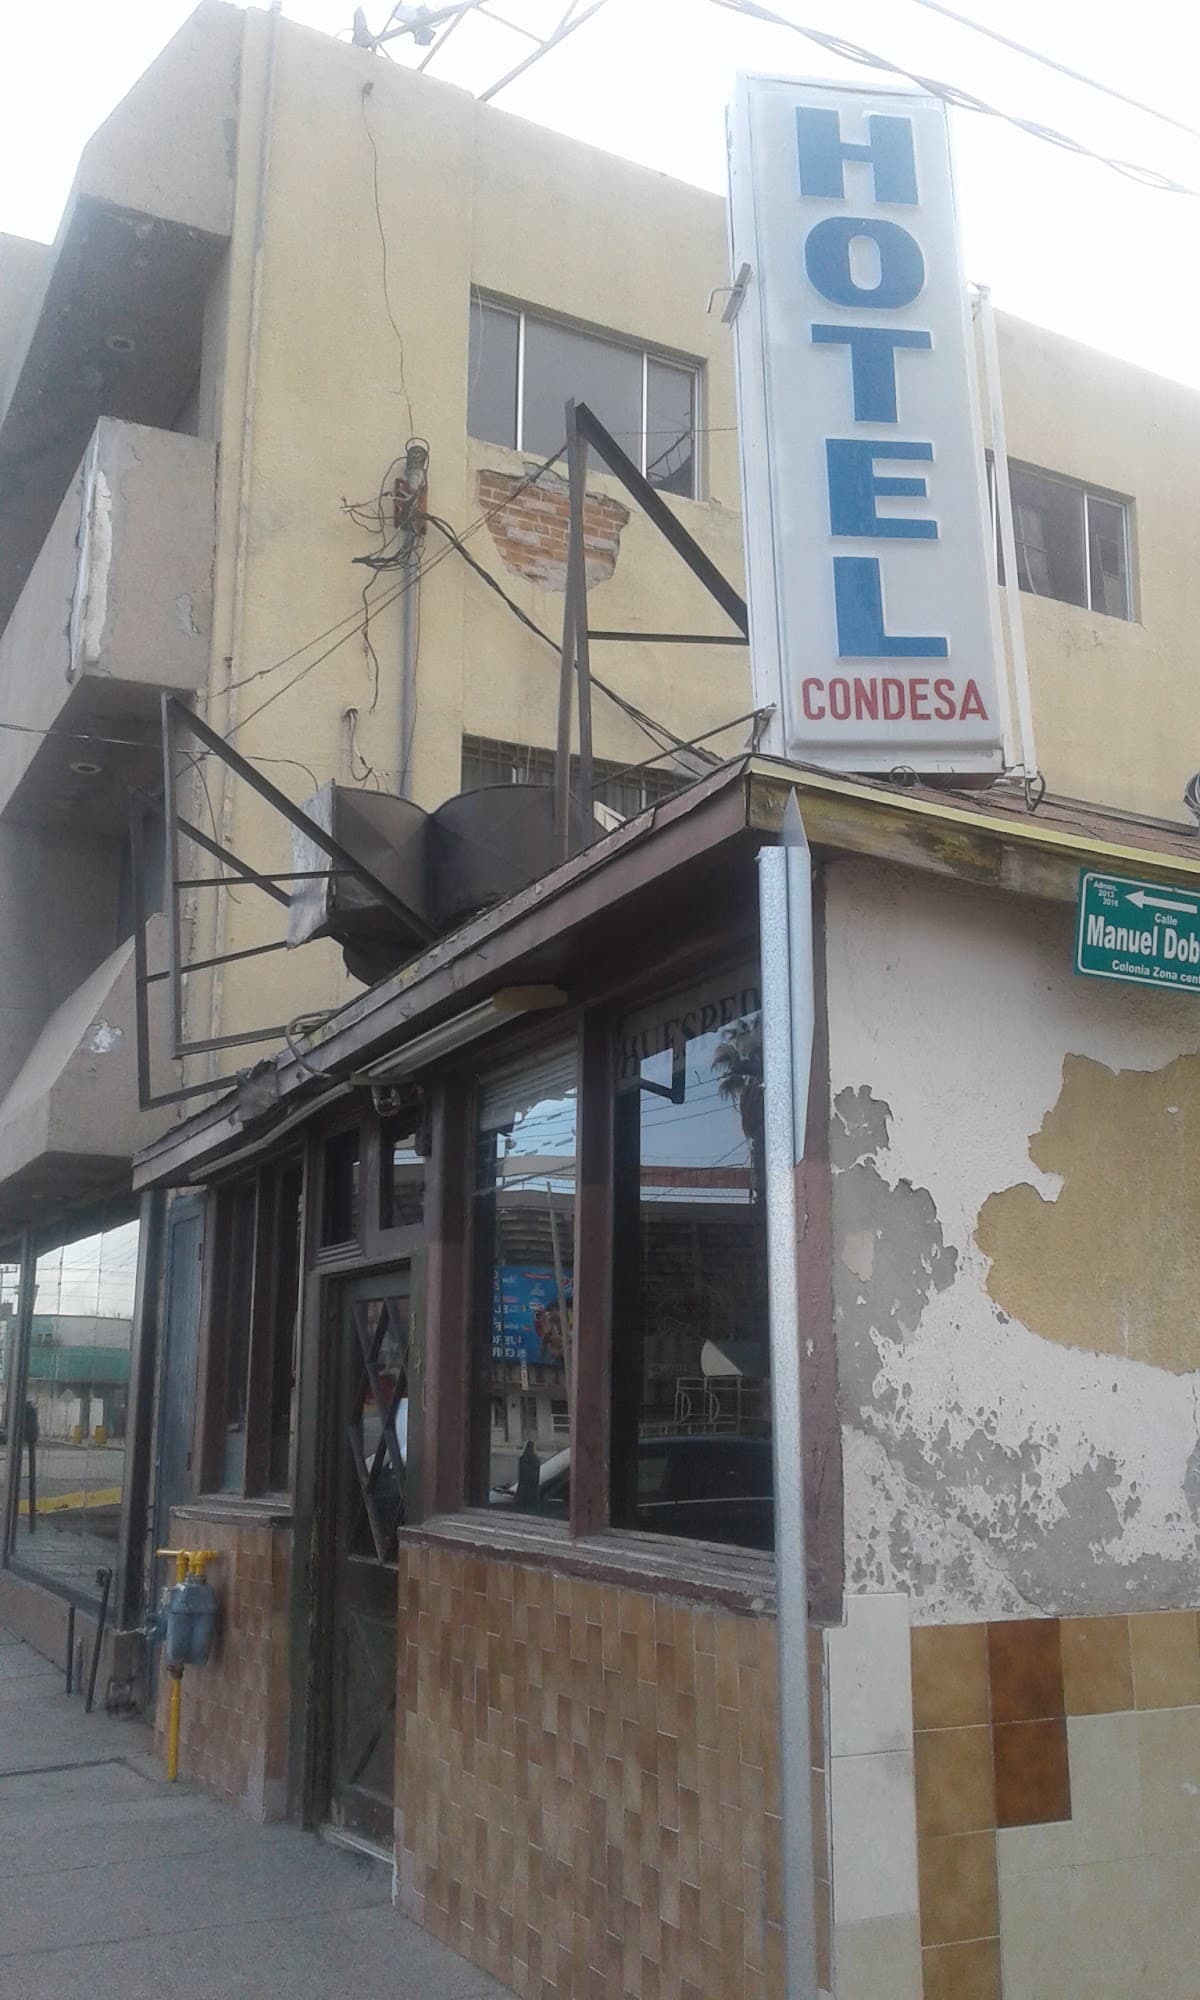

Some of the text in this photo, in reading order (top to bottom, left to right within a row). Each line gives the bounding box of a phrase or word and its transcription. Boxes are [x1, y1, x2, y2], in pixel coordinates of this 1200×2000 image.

[796, 106, 949, 658] HOTEL
[803, 677, 988, 721] CONDESA
[1087, 914, 1158, 956] Manuel
[1154, 913, 1178, 926] Calle
[1112, 960, 1150, 976] Colonia
[1153, 966, 1178, 980] Zona
